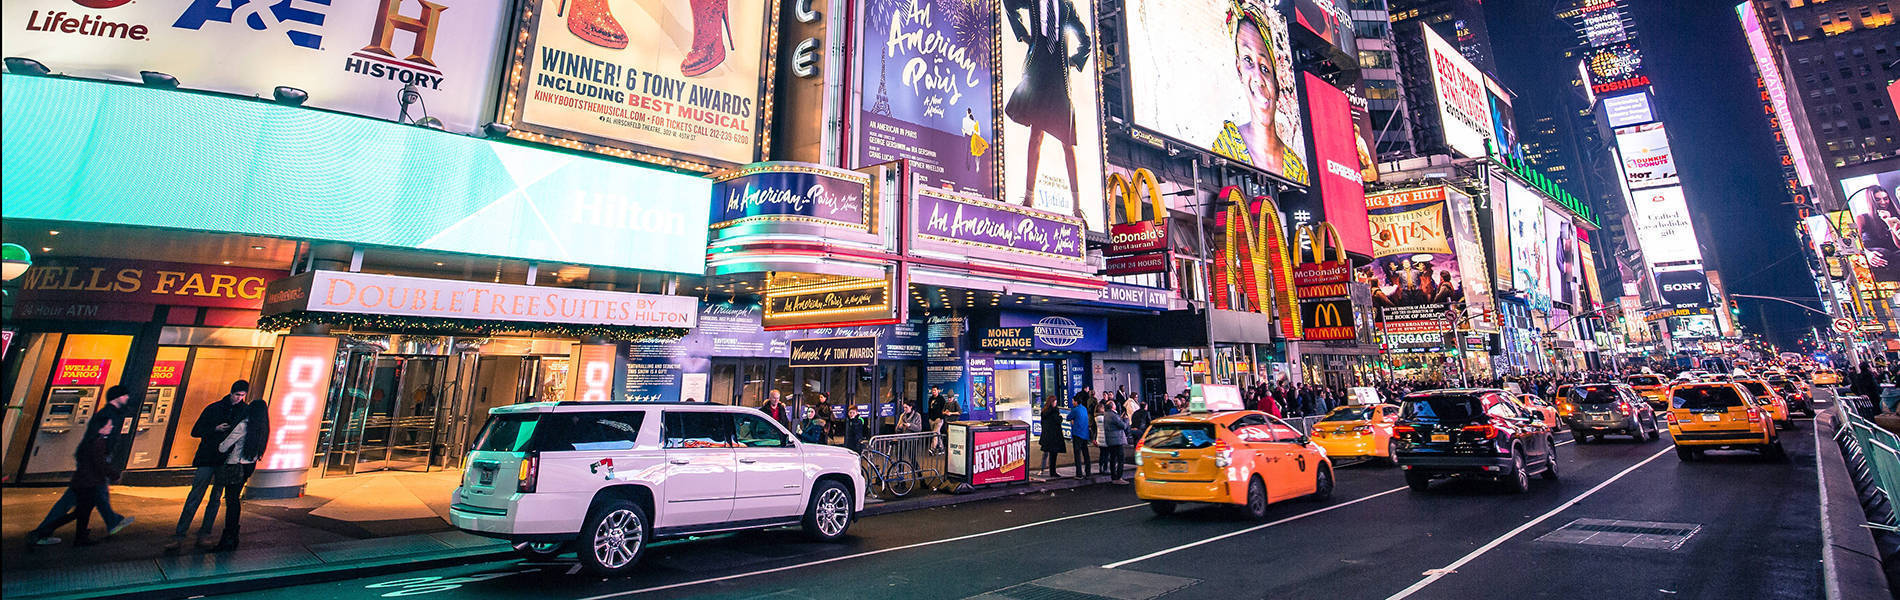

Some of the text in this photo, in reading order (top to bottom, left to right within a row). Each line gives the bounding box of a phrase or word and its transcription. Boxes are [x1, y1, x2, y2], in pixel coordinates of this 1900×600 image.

[906, 0, 932, 28] An
[1581, 1, 1616, 13] TOSHIBA
[27, 10, 148, 40] Lifetime
[1585, 12, 1619, 26] TOSHIBA
[887, 9, 979, 88] American
[934, 54, 943, 63] in
[344, 57, 443, 90] HISTORY
[1434, 48, 1457, 87] BEST
[542, 46, 751, 118] WINNER! 6 TONY AWARDS
[902, 57, 962, 106] Paris
[1592, 75, 1650, 94] TOSHIBA
[537, 73, 749, 132] INCLUDING BEST MUSICAL
[1757, 78, 1782, 143] ERNST
[534, 90, 749, 144] KINKYBOOTSTHEMUSICAL.COM FOR TICKETS CALL 212-239-6200
[877, 123, 899, 134] AMERICAN
[905, 129, 918, 139] PARIS
[1638, 159, 1668, 168] DONUTS
[1630, 171, 1652, 179] HOT
[727, 188, 740, 213] An
[740, 181, 804, 212] American
[802, 194, 810, 203] in
[807, 184, 838, 215] Paris
[1388, 193, 1409, 204] FAT
[572, 190, 687, 237] Hilton
[927, 202, 949, 232] An
[950, 203, 1017, 247] American
[1014, 232, 1022, 240] in
[1017, 218, 1050, 252] Paris
[1112, 241, 1154, 251] Restaurant
[1108, 262, 1126, 270] OPEN
[1137, 259, 1162, 267] HOURS
[1294, 268, 1347, 278] McDonald's
[23, 266, 143, 294] WELLS
[152, 270, 265, 301] FARG
[1663, 282, 1702, 292] SONY
[637, 299, 657, 310] BY
[783, 297, 792, 312] An
[793, 295, 823, 311] American
[825, 293, 843, 308] Paris
[1111, 288, 1143, 302] MONEY
[1149, 292, 1167, 305] ATM
[66, 304, 98, 317] ATM
[635, 311, 687, 323] HILTON
[988, 328, 1022, 338] MONEY
[1053, 327, 1084, 336] EXCHANGE
[1381, 333, 1441, 345] LUGGAGE
[982, 338, 1032, 347] EXCHANGE
[792, 344, 823, 361] Winner!
[824, 347, 832, 360] 4
[833, 348, 848, 359] TONY
[849, 347, 874, 359] AWARDS
[65, 364, 100, 372] WELLS
[973, 445, 1006, 474] JERSEY
[1007, 439, 1026, 465] BOYS
